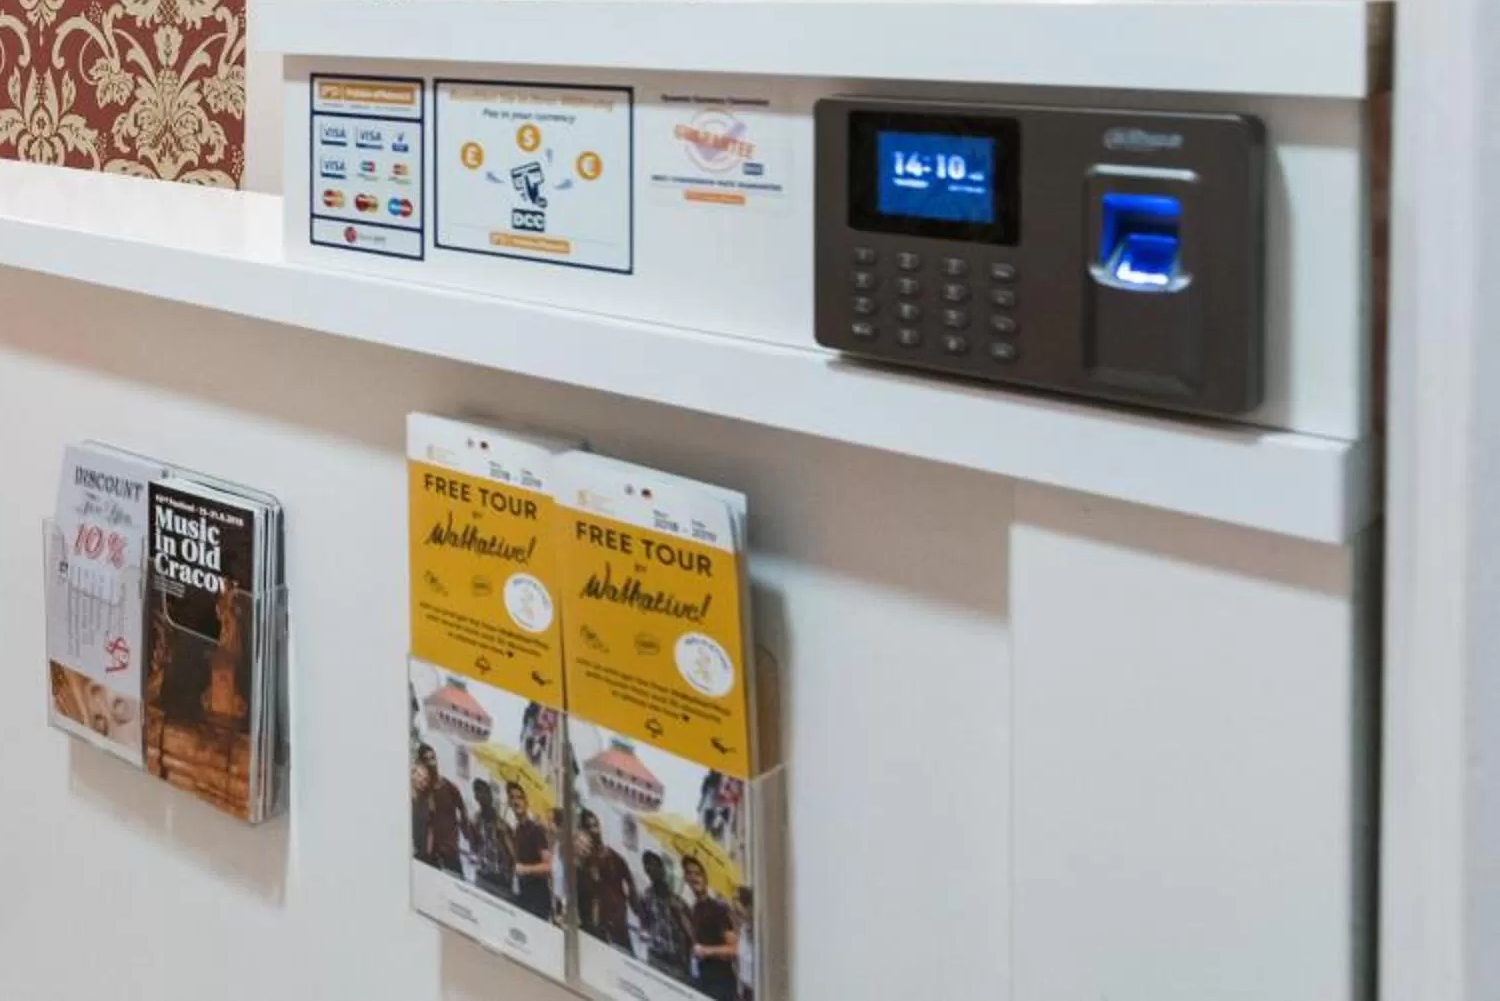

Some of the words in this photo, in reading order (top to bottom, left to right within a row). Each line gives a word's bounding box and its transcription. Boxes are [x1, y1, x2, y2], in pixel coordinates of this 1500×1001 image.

[514, 213, 545, 230] DCC
[74, 464, 144, 503] DISCOUNT
[423, 472, 471, 504] FREE
[478, 487, 538, 520] TOUR
[156, 504, 220, 546] Music
[181, 537, 221, 572] Old
[574, 520, 634, 555] FREE
[640, 538, 713, 579] TOUR
